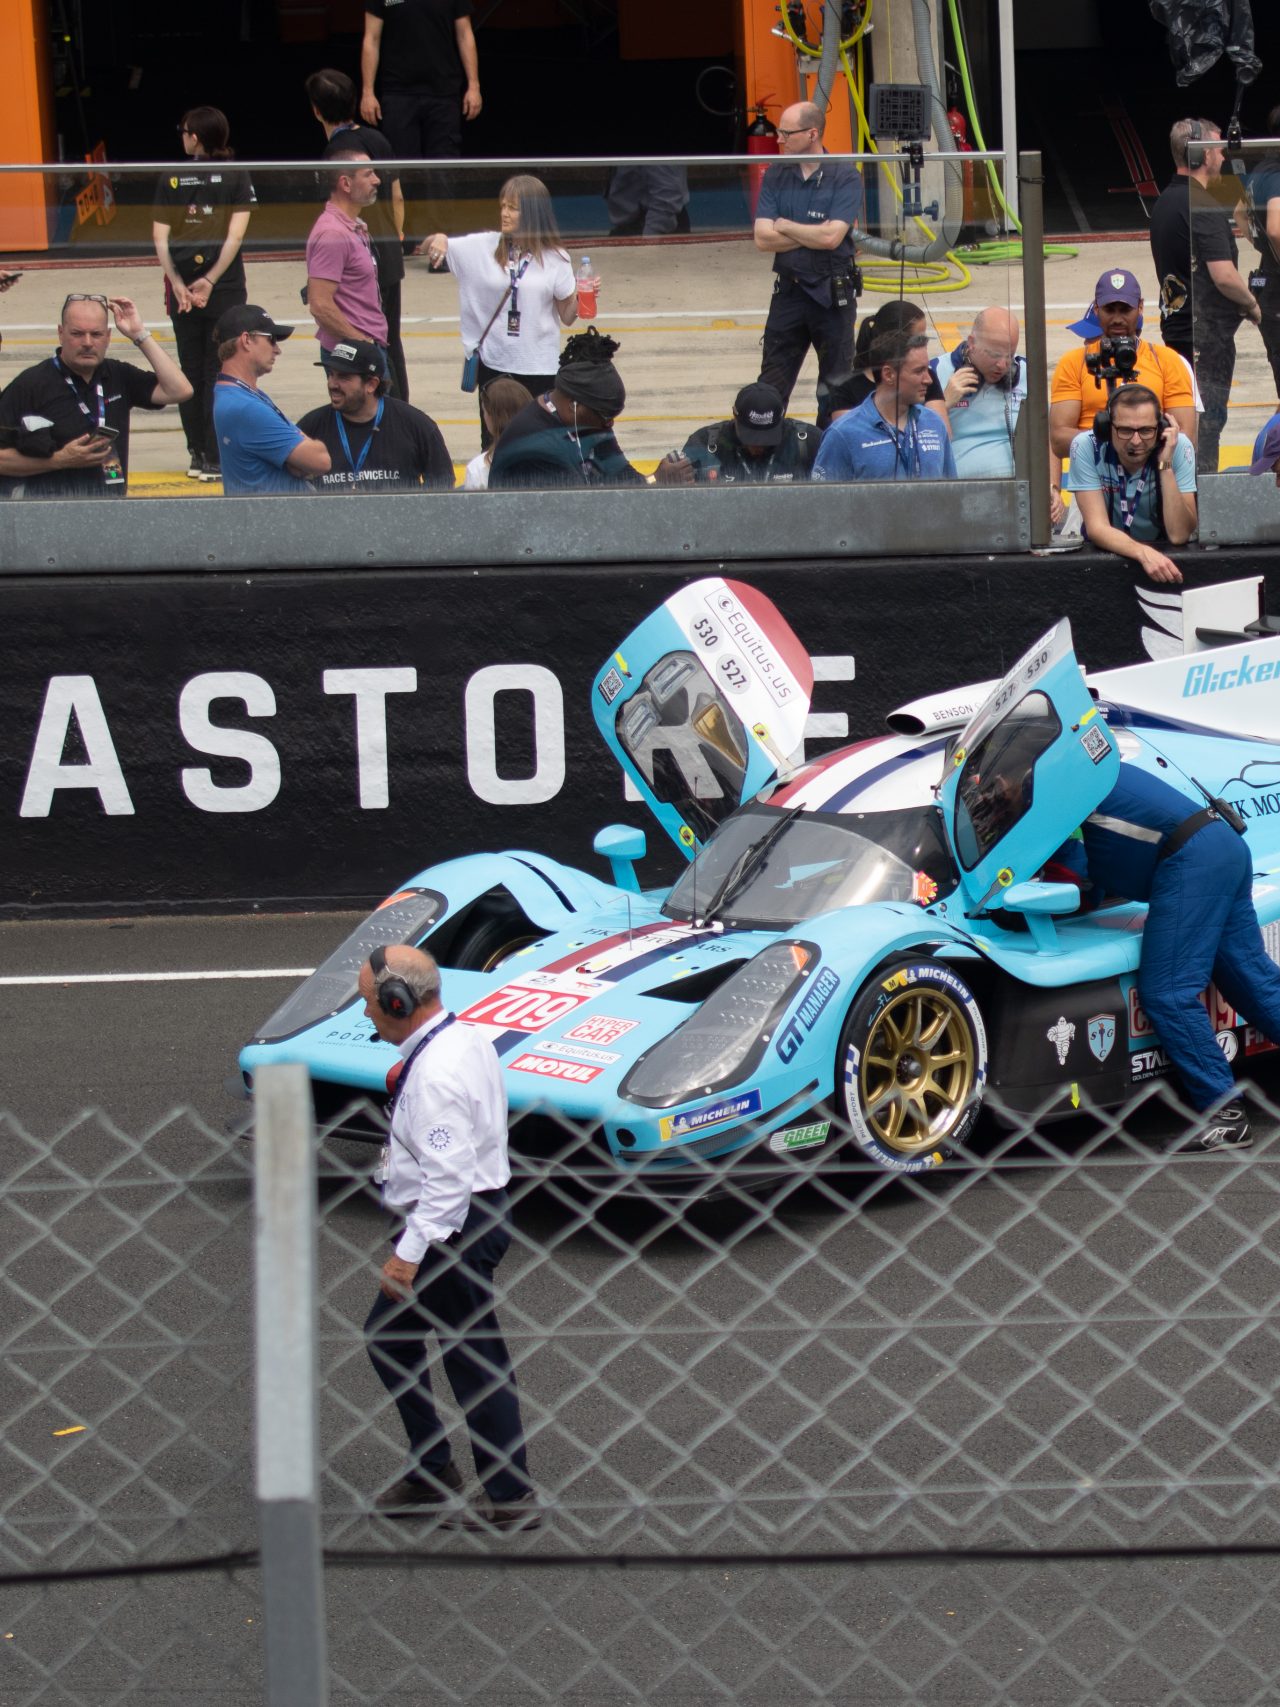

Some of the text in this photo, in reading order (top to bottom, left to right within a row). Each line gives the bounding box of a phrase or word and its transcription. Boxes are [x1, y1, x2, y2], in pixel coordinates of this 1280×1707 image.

[322, 472, 346, 484] RACE
[347, 469, 384, 483] SERVICE
[694, 618, 719, 648] 530
[727, 611, 793, 699] Equitus.us
[1026, 650, 1049, 680] 530
[720, 659, 748, 690] 527
[994, 682, 1016, 713] 527
[932, 705, 974, 721] BENSON
[917, 967, 971, 999] MICHELIN
[465, 986, 580, 1027] 709
[799, 970, 838, 1027] MANAGER
[569, 1023, 622, 1043] CAR
[584, 1015, 632, 1033] HYPER
[557, 1044, 616, 1062] Equitus.us
[776, 1015, 804, 1064] GT
[514, 1057, 593, 1083] MOTUL
[690, 1099, 751, 1127] MICHELIN
[849, 1091, 860, 1117] SPORT
[783, 1122, 830, 1144] GREEN
